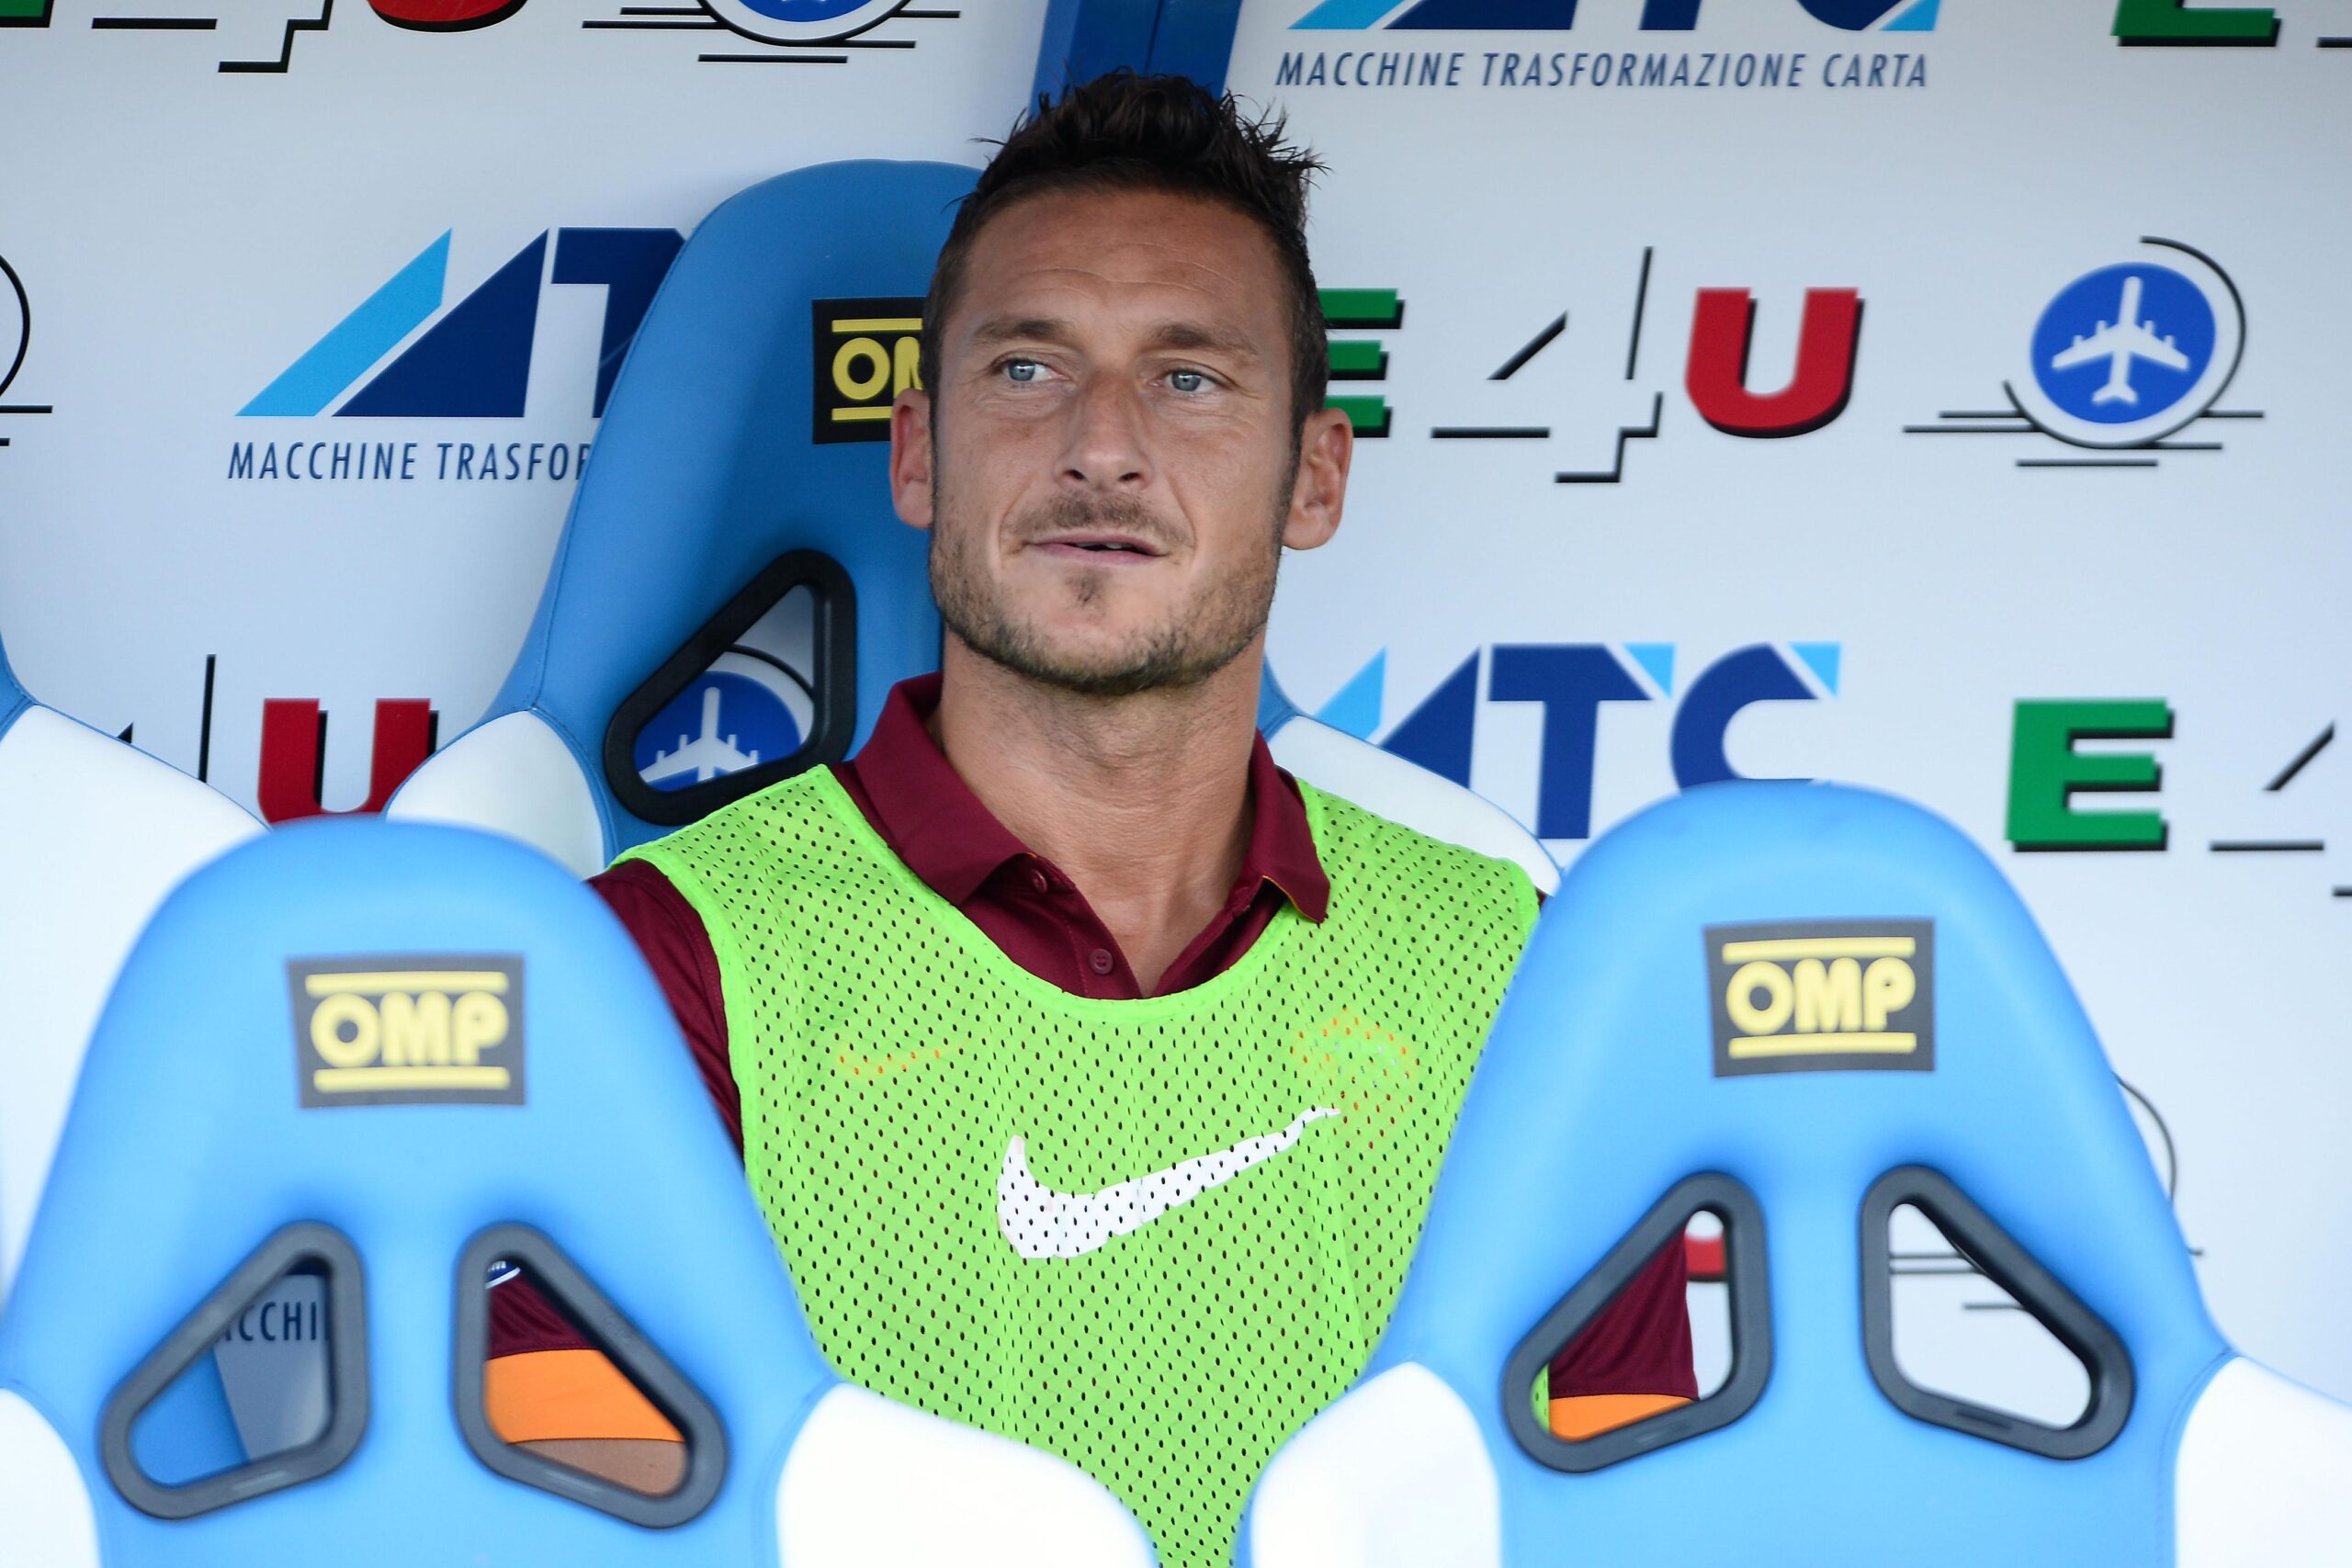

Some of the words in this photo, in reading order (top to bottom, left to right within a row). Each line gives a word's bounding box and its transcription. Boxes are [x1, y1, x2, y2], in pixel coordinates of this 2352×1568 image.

[1275, 52, 1465, 86] MACCHINE
[1482, 52, 1807, 86] TRASFORMAZIONE
[1823, 53, 1926, 87] CARTA
[228, 441, 418, 480] MACCHINE
[1725, 957, 1917, 1036] OMP
[310, 990, 509, 1068] OMP
